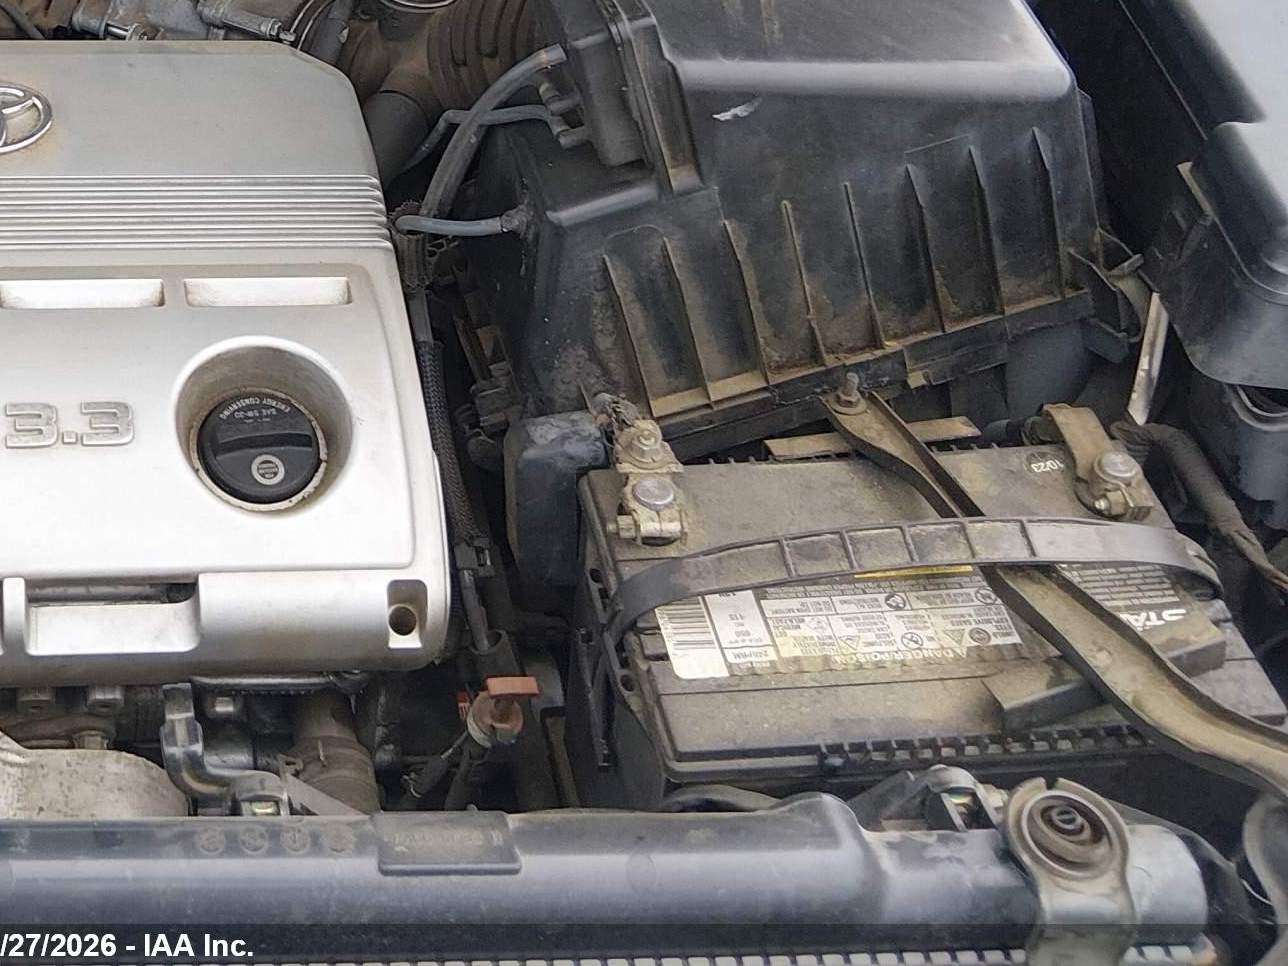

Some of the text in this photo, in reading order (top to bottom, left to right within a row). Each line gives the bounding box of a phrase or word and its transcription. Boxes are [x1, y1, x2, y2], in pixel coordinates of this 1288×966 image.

[218, 397, 291, 420] ENERGY CONSERVING
[4, 400, 136, 450] 3.3
[1030, 458, 1065, 473] 10/23
